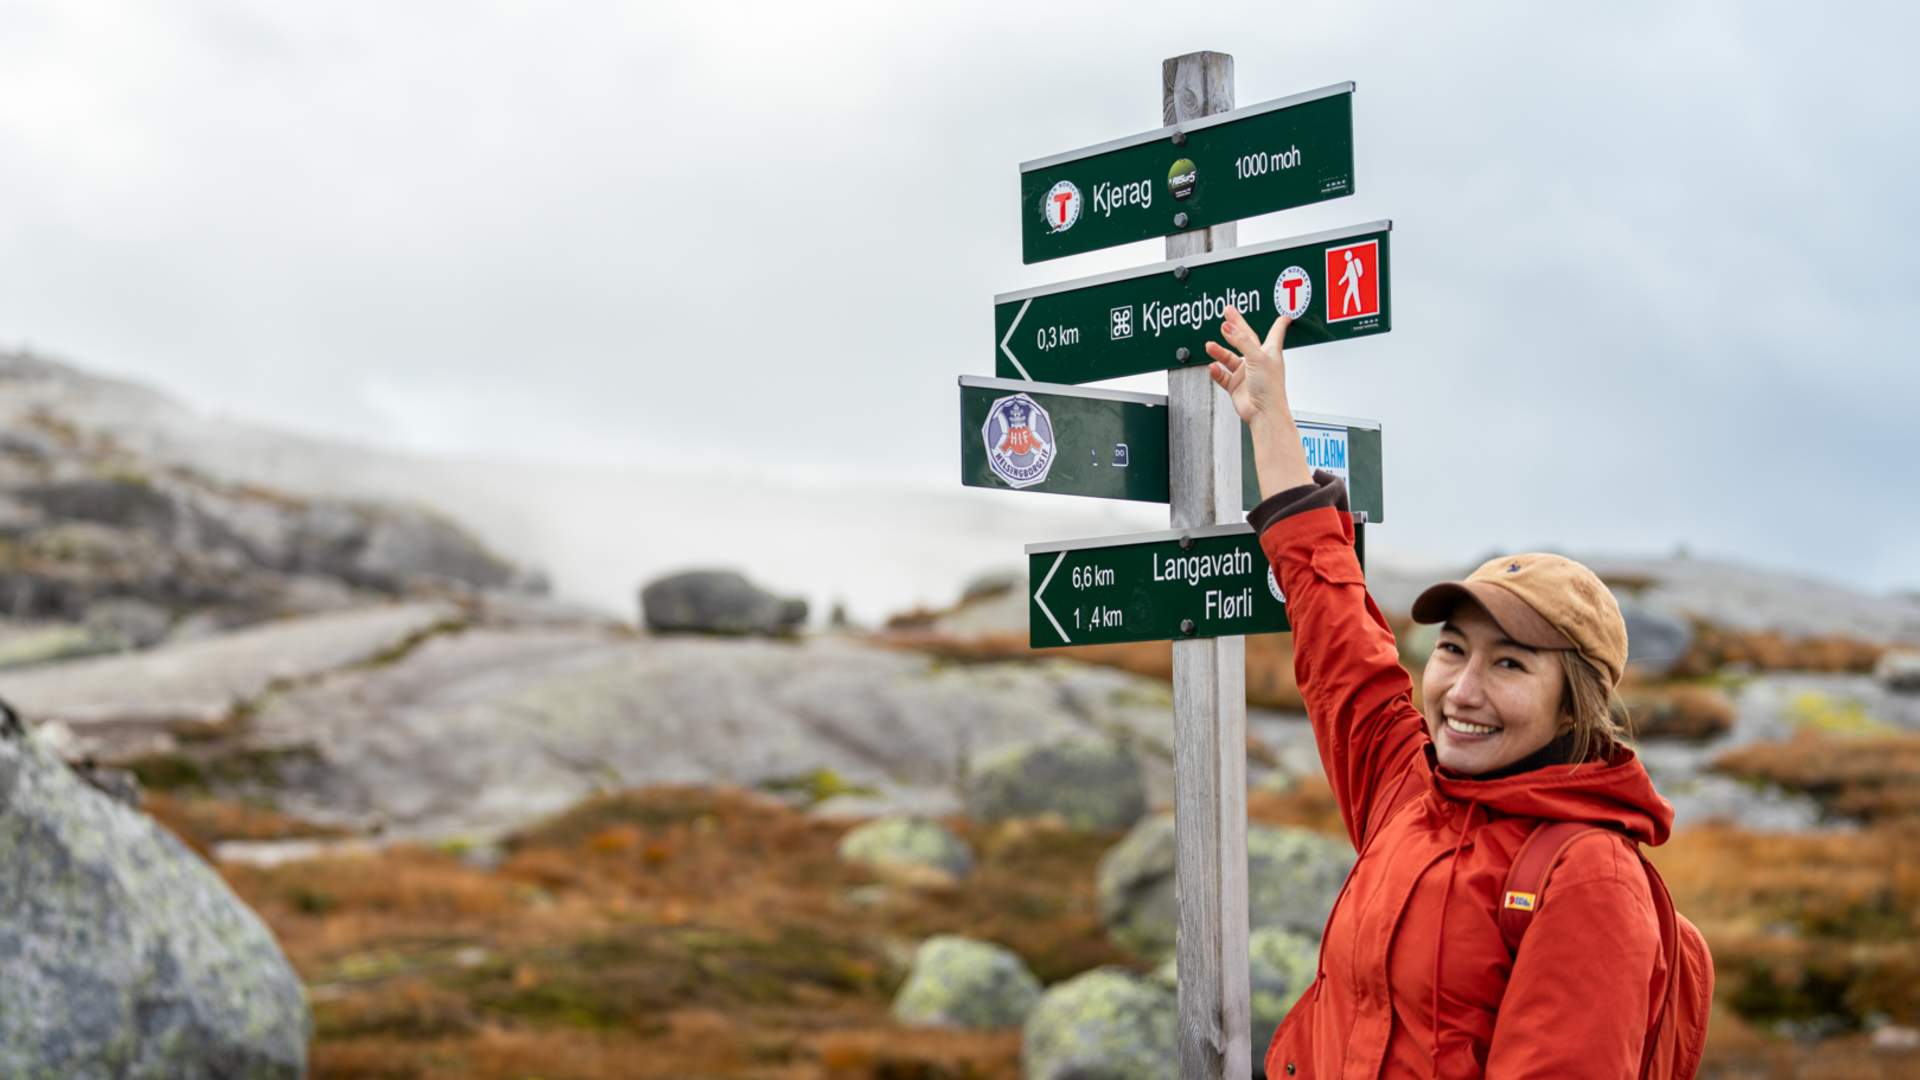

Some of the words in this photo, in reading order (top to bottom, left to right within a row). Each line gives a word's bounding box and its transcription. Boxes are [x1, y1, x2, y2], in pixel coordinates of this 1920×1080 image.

[1235, 151, 1268, 179] 1000
[1270, 145, 1301, 172] moh
[1053, 192, 1073, 224] T
[1093, 180, 1152, 218] Kjerag
[1282, 278, 1304, 312] T
[1142, 287, 1261, 338] Kjeragbolten
[1037, 327, 1057, 351] 0,3
[1059, 325, 1079, 346] km
[1010, 431, 1029, 446] HIF
[1318, 432, 1346, 469] LÄRM
[995, 451, 1047, 478] HELSINGBORGS
[1072, 565, 1093, 591] 6,6
[1094, 565, 1115, 587] km
[1153, 547, 1252, 586] Langavatn
[1103, 605, 1123, 627] km
[1205, 588, 1252, 620] Flørli
